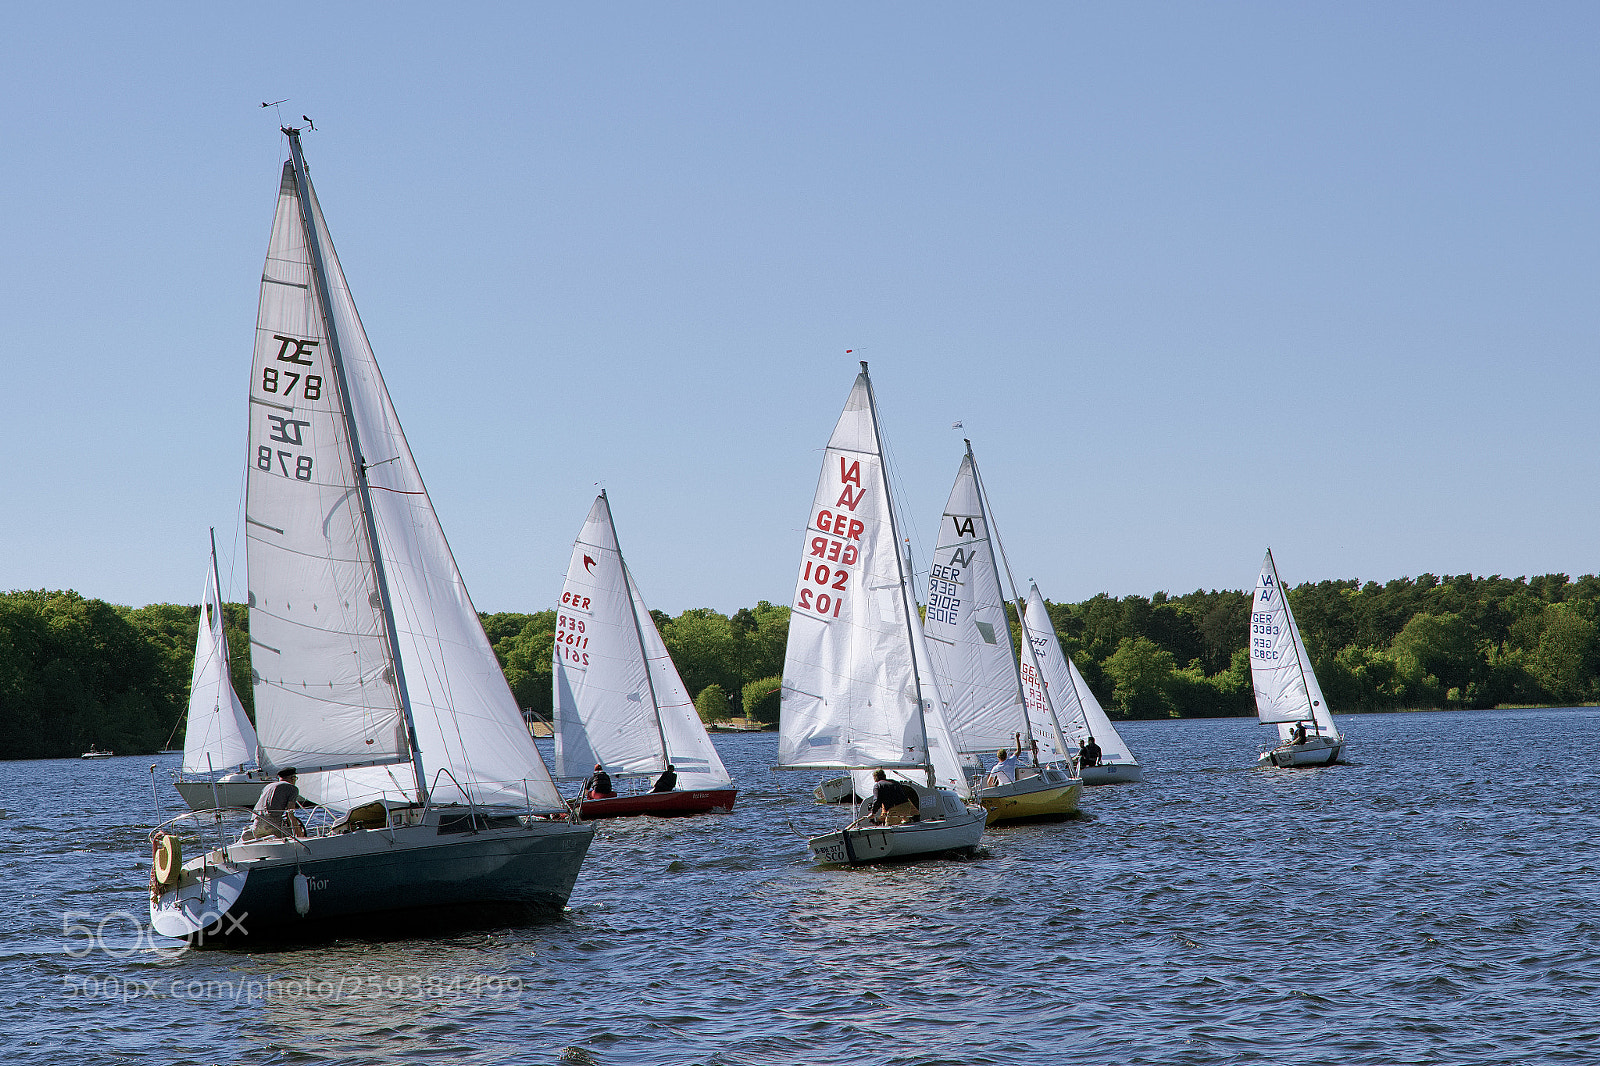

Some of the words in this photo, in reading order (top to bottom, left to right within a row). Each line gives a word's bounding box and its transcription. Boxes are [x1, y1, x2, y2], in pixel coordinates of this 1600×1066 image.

[263, 367, 322, 400] 878
[816, 509, 865, 541] GER
[952, 516, 976, 538] VA
[803, 560, 849, 591] 102
[932, 563, 960, 583] GER
[1261, 574, 1274, 587] VA
[562, 591, 591, 610] GER
[1252, 613, 1273, 624] GER
[1252, 624, 1279, 635] 3383
[556, 630, 589, 650] 2611
[1022, 662, 1038, 678] GE
[825, 851, 845, 862] SCO
